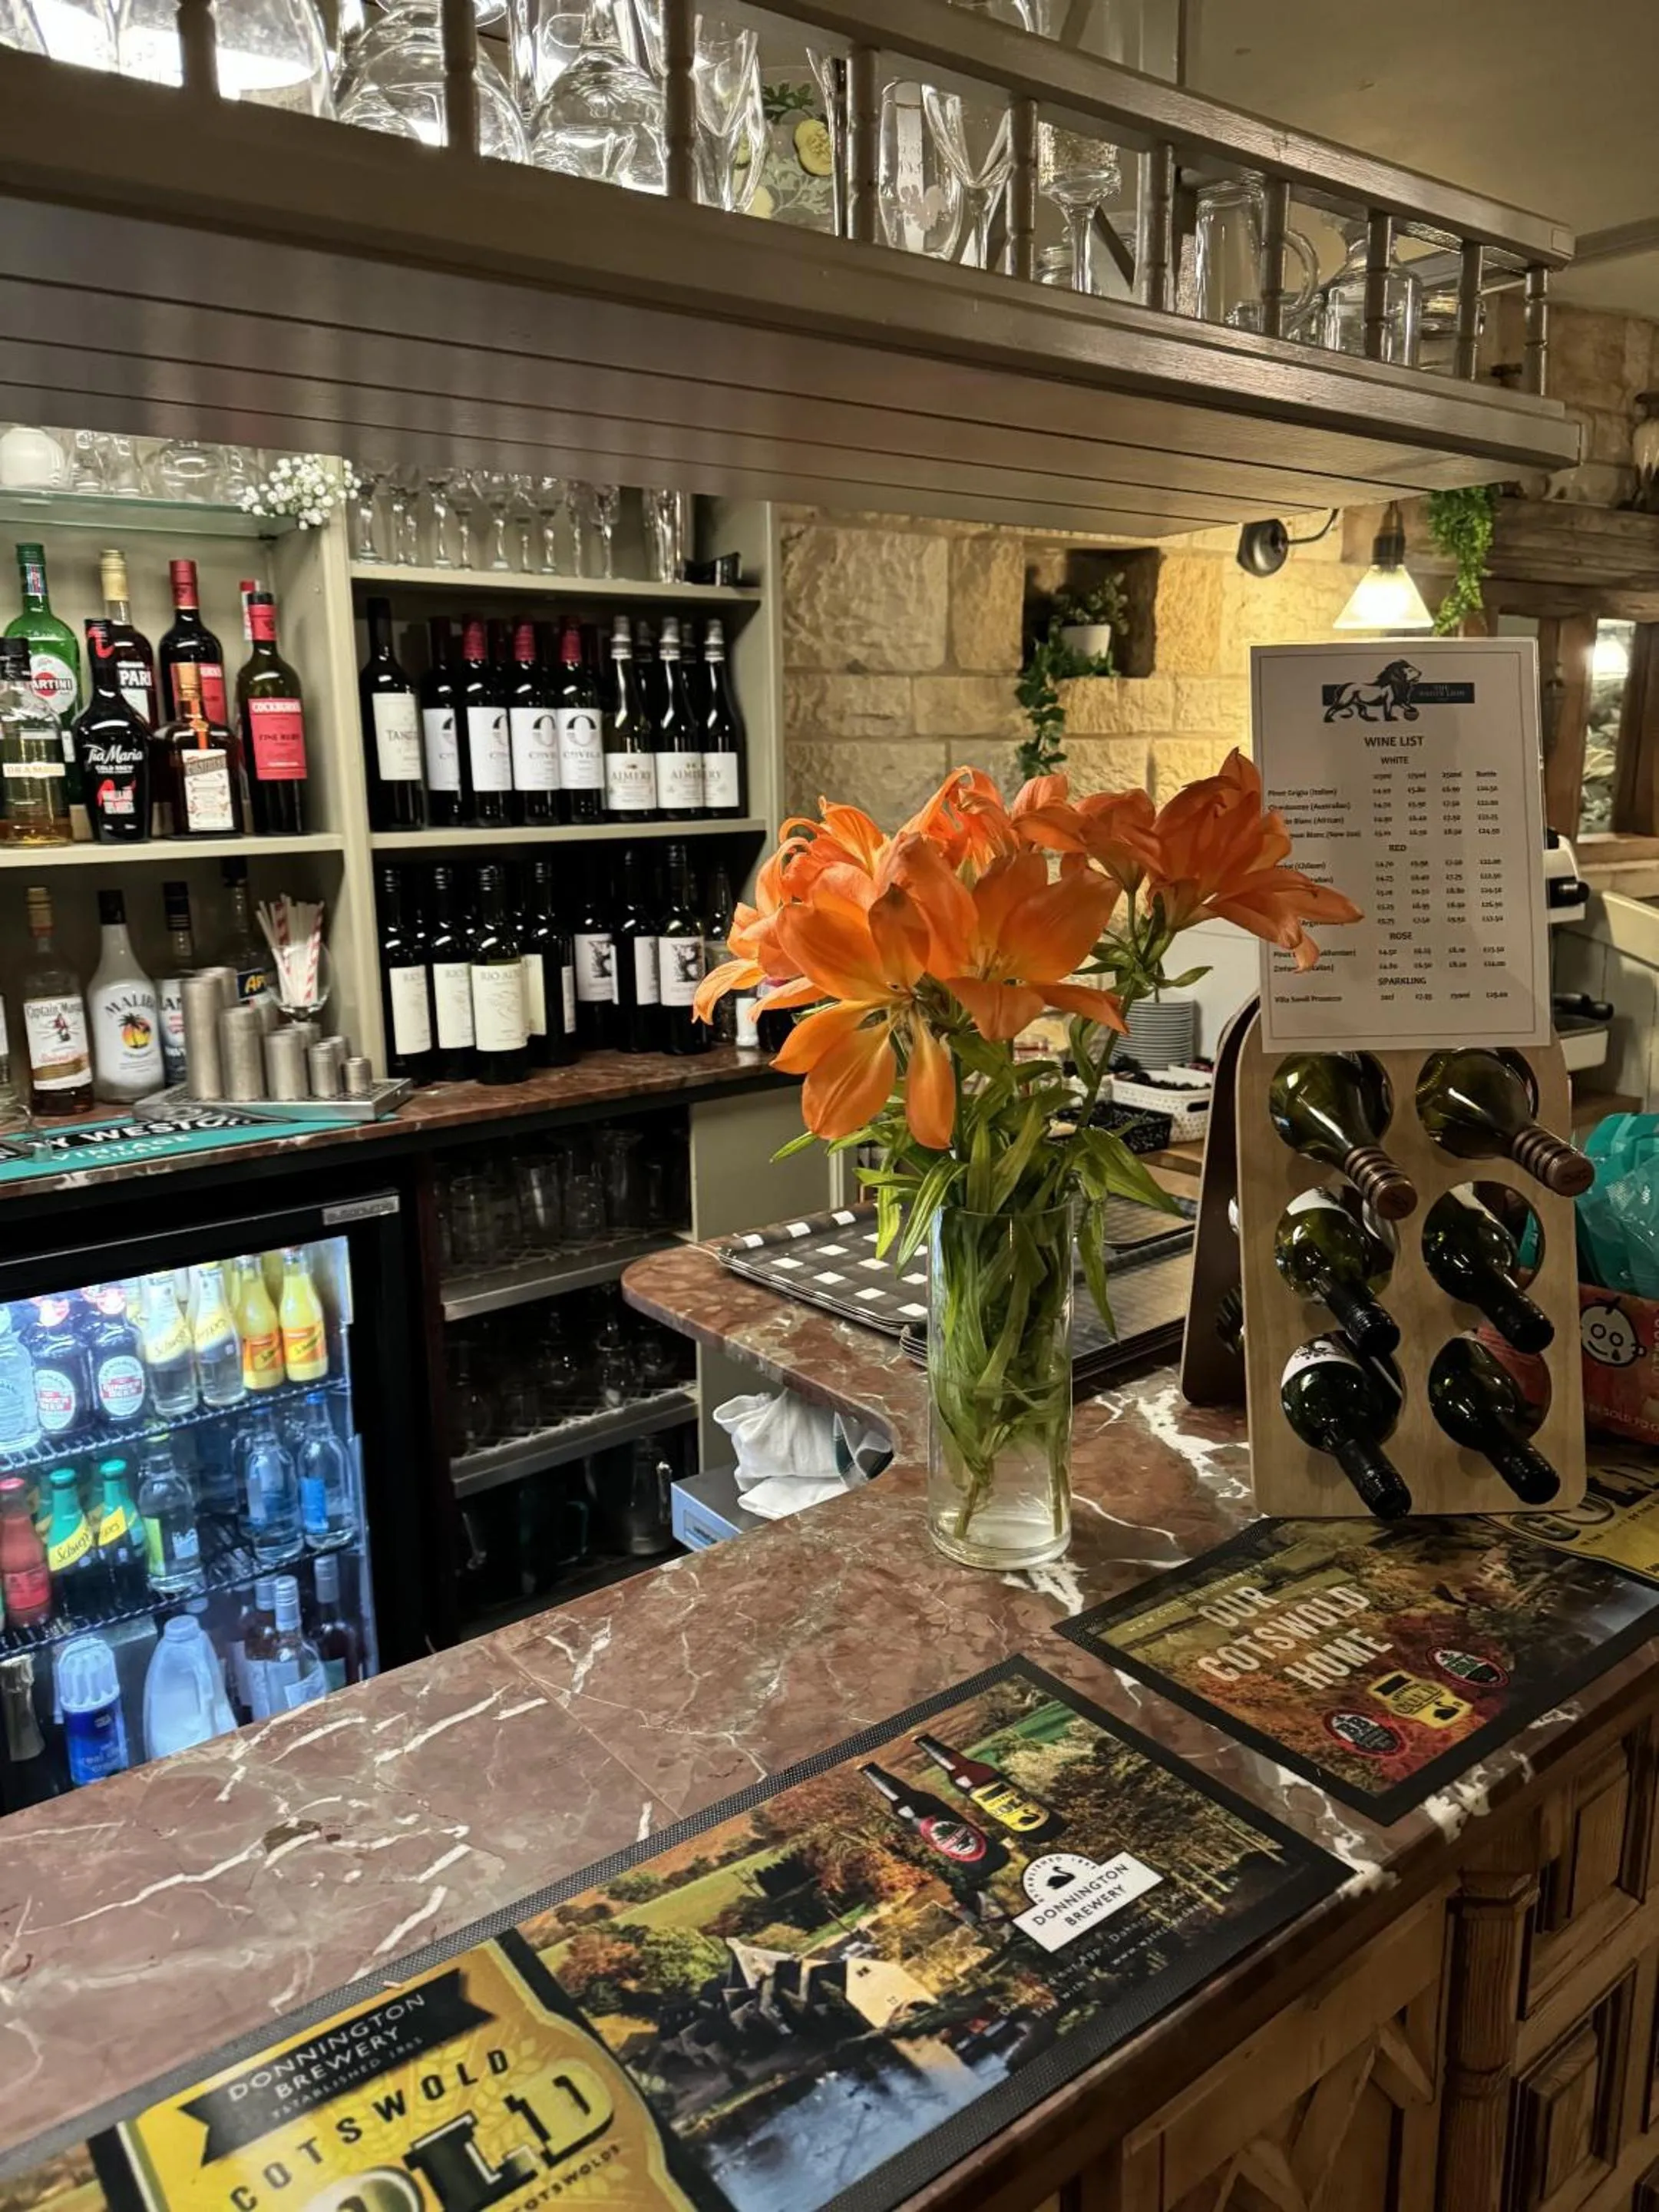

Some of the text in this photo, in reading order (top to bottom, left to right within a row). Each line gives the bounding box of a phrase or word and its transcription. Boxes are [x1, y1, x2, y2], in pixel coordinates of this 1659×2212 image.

[32, 678, 72, 691] ARTINI
[83, 744, 144, 765] Tia Maria
[1364, 736, 1424, 747] WINE LIST
[1381, 756, 1409, 765] WHITE
[1390, 931, 1413, 941] ROSE
[1378, 977, 1426, 986] SPARKLING
[1198, 1586, 1280, 1627] OUR
[1198, 1585, 1370, 1681] COTSWOLD
[1284, 1627, 1394, 1689] HOME
[1032, 1863, 1130, 1926] DONNINGTON
[1064, 1884, 1127, 1927] BREWERY
[227, 1993, 426, 2102] DONNINGTON
[274, 2026, 401, 2100] BREWERY
[272, 2058, 382, 2120] ESTABLISHED
[230, 2048, 509, 2212] COTSWOLD
[510, 2143, 621, 2212] OTSWOLDS
